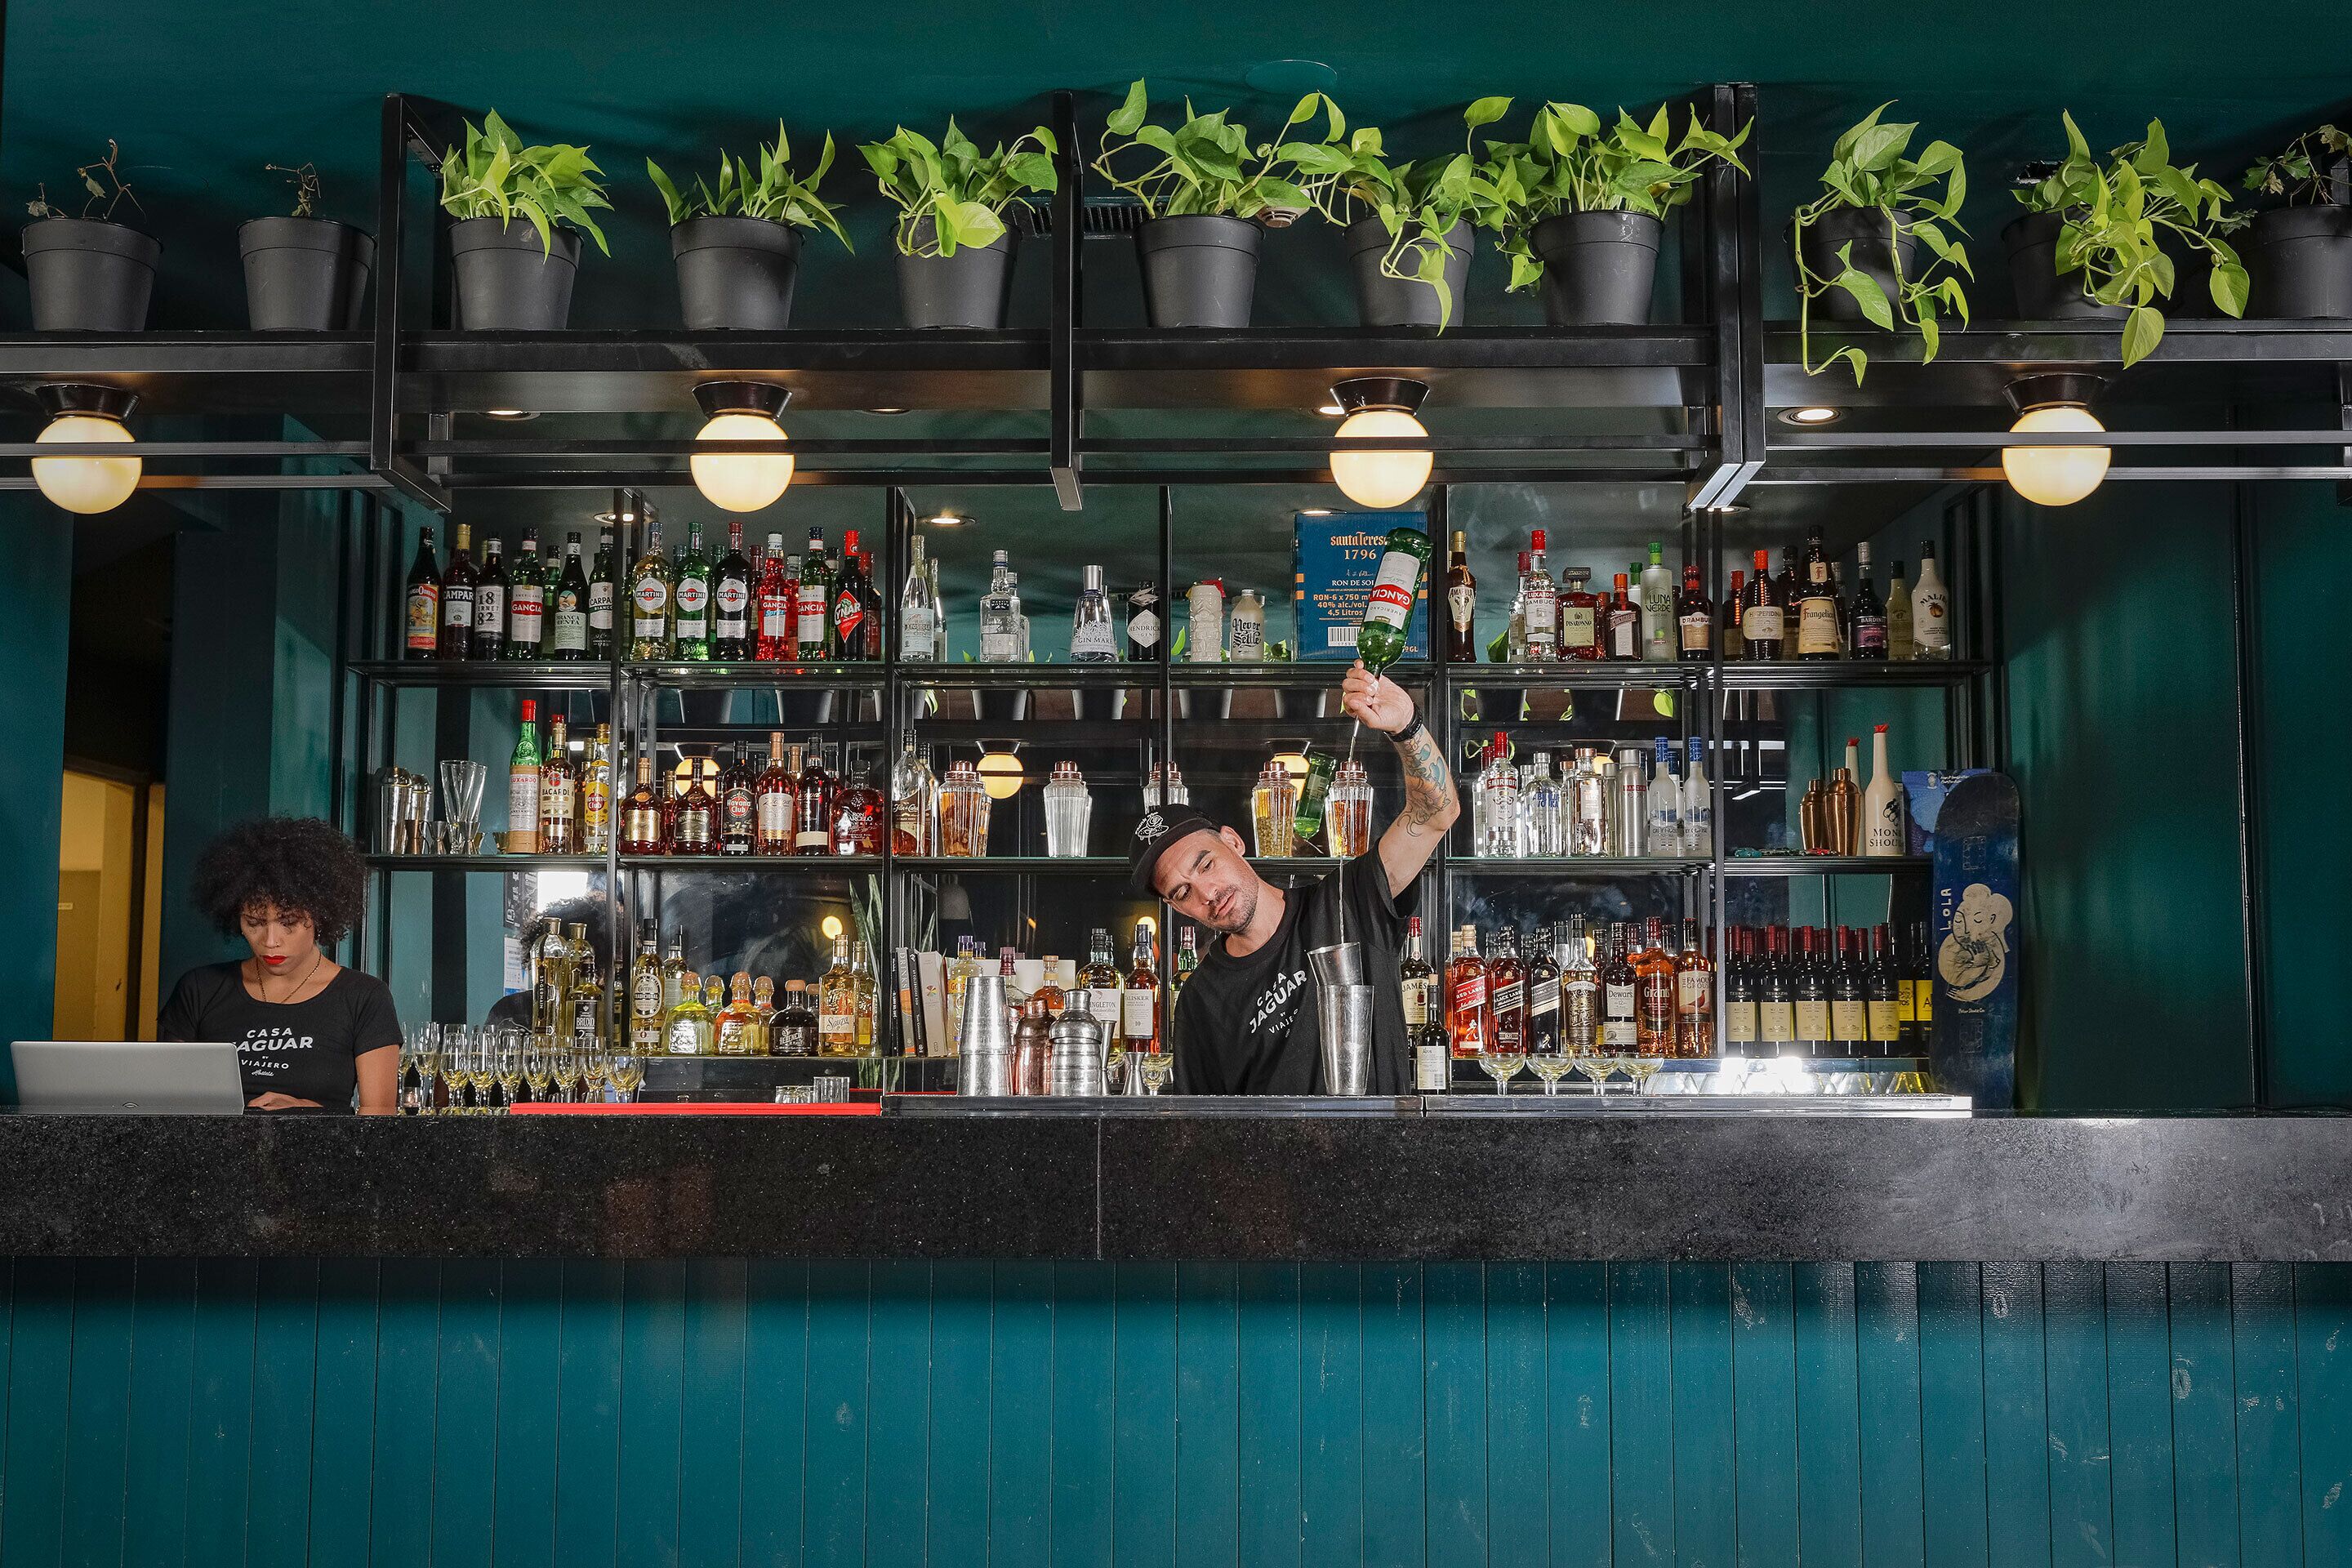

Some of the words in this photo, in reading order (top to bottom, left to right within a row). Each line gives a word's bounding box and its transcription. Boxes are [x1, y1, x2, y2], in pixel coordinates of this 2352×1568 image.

[1344, 550, 1377, 560] 1796
[636, 590, 664, 599] MARTINI
[1372, 589, 1411, 605] GANCIA
[1650, 594, 1671, 604] LUNA
[1919, 593, 1948, 608] MALIB
[511, 604, 542, 613] GANCIA
[1646, 604, 1671, 612] VERDE
[1232, 618, 1261, 631] Never
[541, 787, 570, 796] BACARDÍ
[727, 799, 752, 807] Havana
[1869, 838, 1903, 847] SHOU
[1940, 888, 1952, 930] LOLA
[899, 952, 908, 988] DRINKS
[1257, 972, 1287, 1007] CASA
[1401, 982, 1428, 992] JAMES
[1456, 991, 1468, 1000] RED
[1496, 993, 1508, 1002] LACK
[1249, 970, 1307, 1034] JAGUAR
[826, 1016, 849, 1031] Sauza
[1268, 1009, 1298, 1034] VIAJEO
[247, 1027, 292, 1039] CASA
[578, 1030, 585, 1040] 2
[233, 1036, 314, 1052] AGUAR
[241, 1059, 289, 1070] VIAJERO
